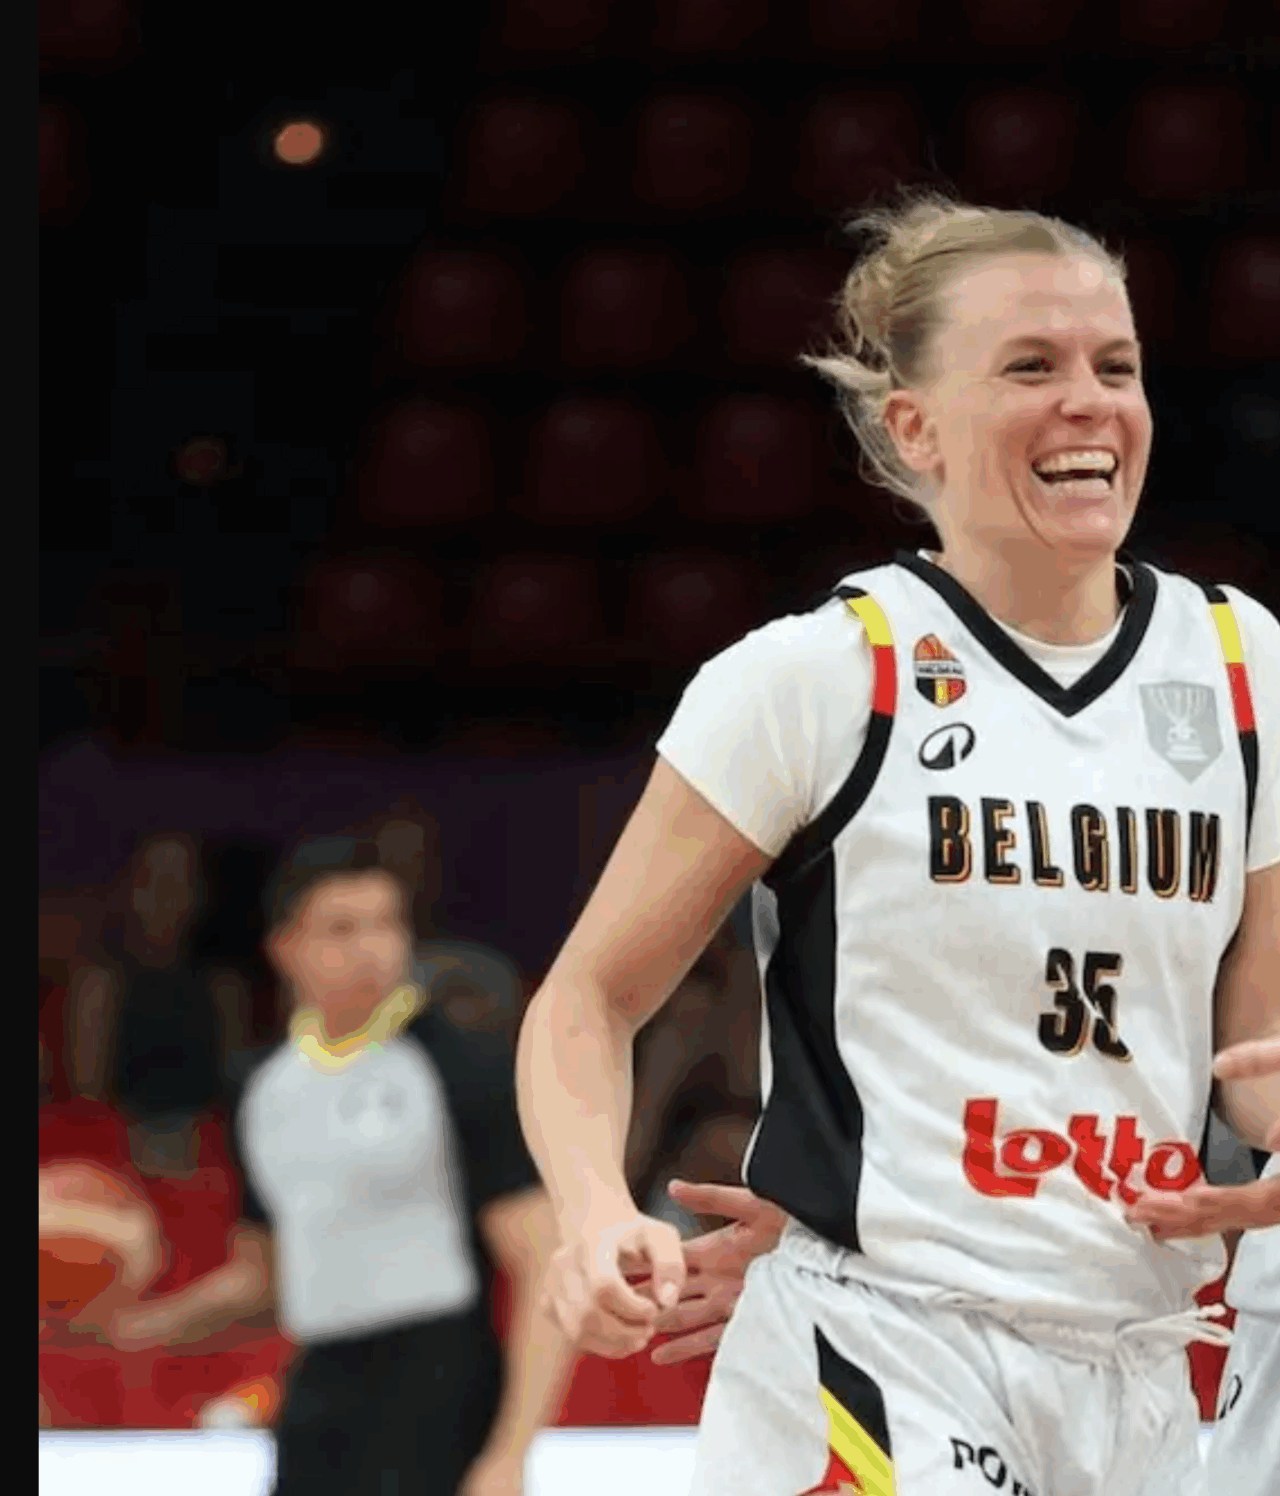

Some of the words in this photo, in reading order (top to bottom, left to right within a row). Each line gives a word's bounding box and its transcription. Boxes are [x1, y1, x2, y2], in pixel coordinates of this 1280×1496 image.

[927, 795, 1220, 904] BELGIUM
[1037, 947, 1133, 1063] 35
[962, 1097, 1201, 1206] Lotto
[948, 1436, 1033, 1496] PO
